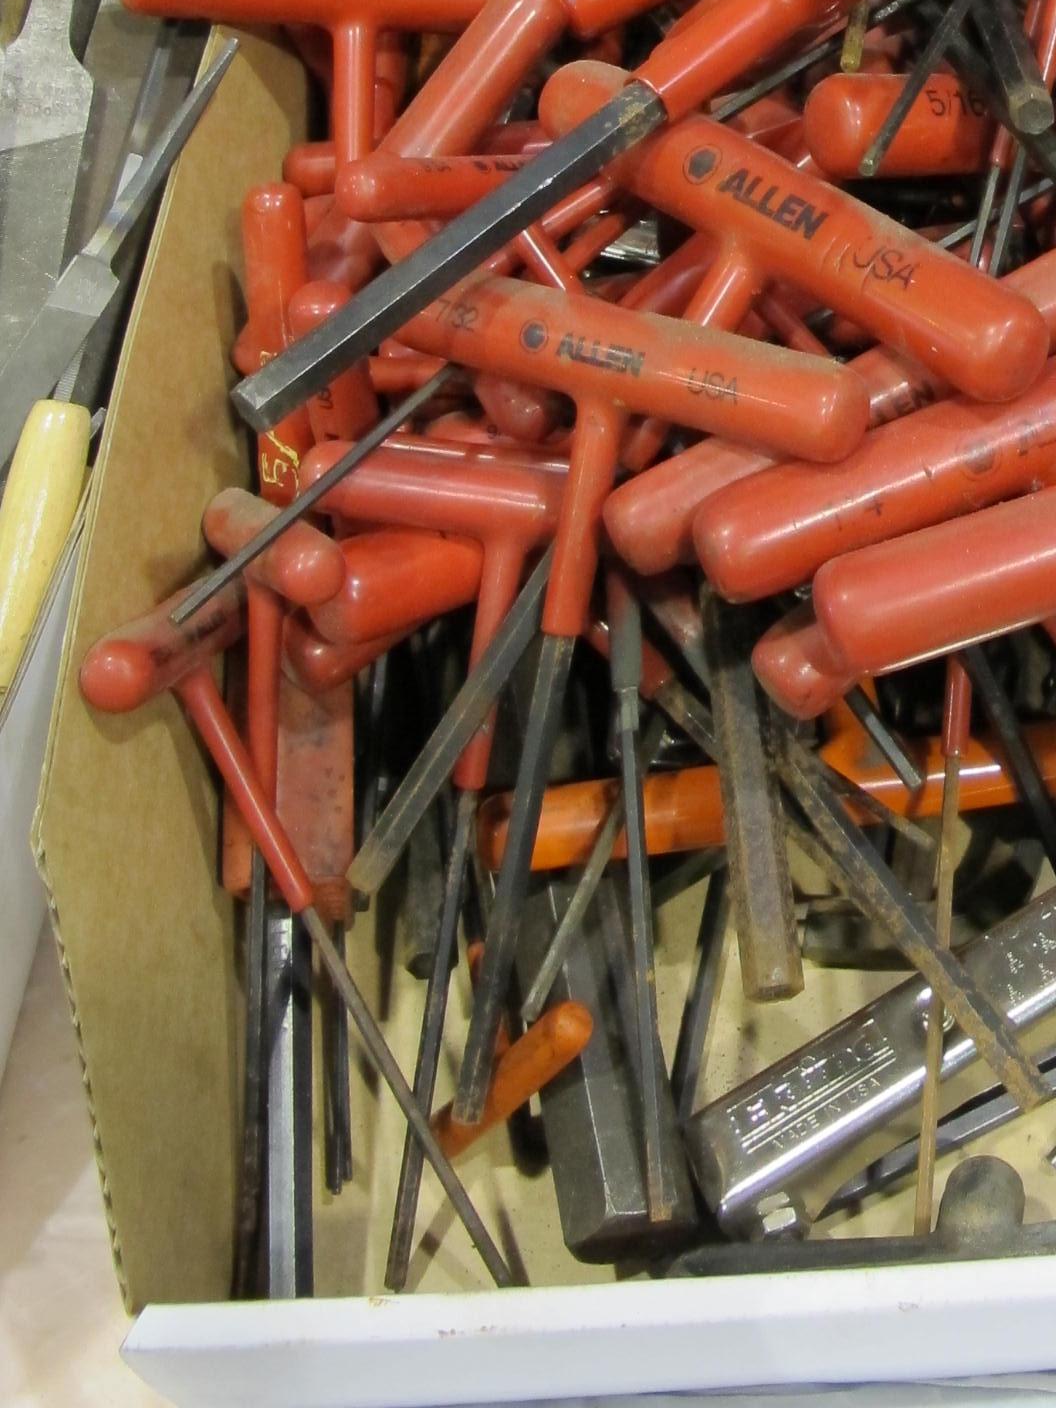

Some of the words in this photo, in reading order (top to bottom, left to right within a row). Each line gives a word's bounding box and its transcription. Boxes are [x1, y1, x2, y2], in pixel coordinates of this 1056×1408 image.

[716, 168, 829, 241] ALLEN
[853, 245, 920, 289] USA
[555, 331, 647, 378] ALLEN
[688, 367, 739, 407] USA
